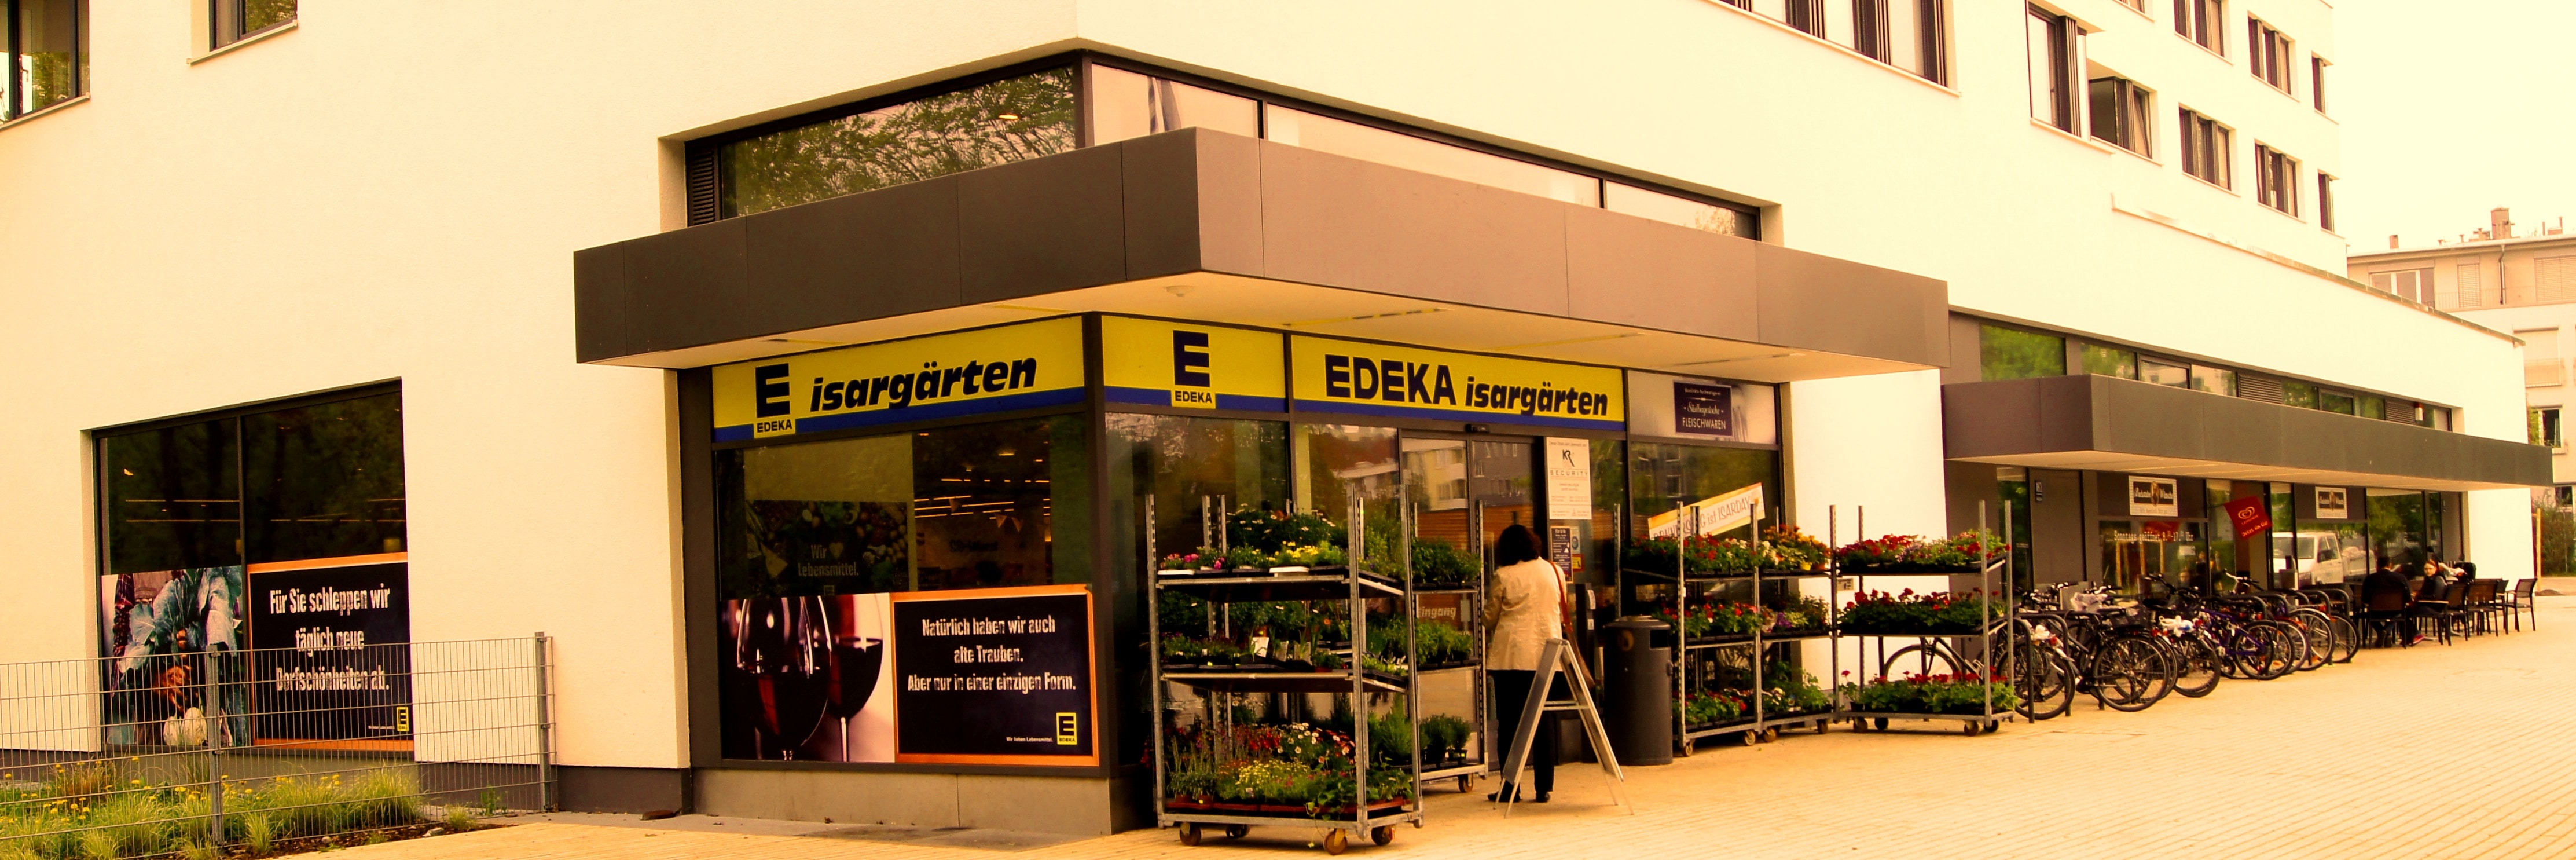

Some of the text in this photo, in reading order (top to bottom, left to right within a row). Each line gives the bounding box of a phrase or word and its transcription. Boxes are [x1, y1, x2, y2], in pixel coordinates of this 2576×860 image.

[1173, 330, 1210, 387] E
[755, 363, 791, 418] E
[810, 357, 1037, 411] isargärten
[1325, 354, 1608, 416] EDEKA isargärten
[1175, 390, 1213, 404] EDEKA
[757, 419, 793, 433] EDEKA
[1682, 417, 1726, 430] FLEISCHWAREN
[1708, 514, 1717, 525] ist
[1718, 496, 1751, 521] ISARDAY
[810, 544, 827, 559] Wir
[797, 561, 860, 577] Lebensmittel.
[270, 583, 391, 617] Für Sie schleppen wir
[922, 614, 1056, 636] Natürlich haben wir auch
[295, 627, 365, 657] täglich neue
[953, 645, 1024, 663] alte Trauben.
[276, 664, 390, 691] Dorfschönheiten ab.
[907, 671, 1077, 694] Aber nur in einer einzigen Form.
[1059, 716, 1074, 736] E
